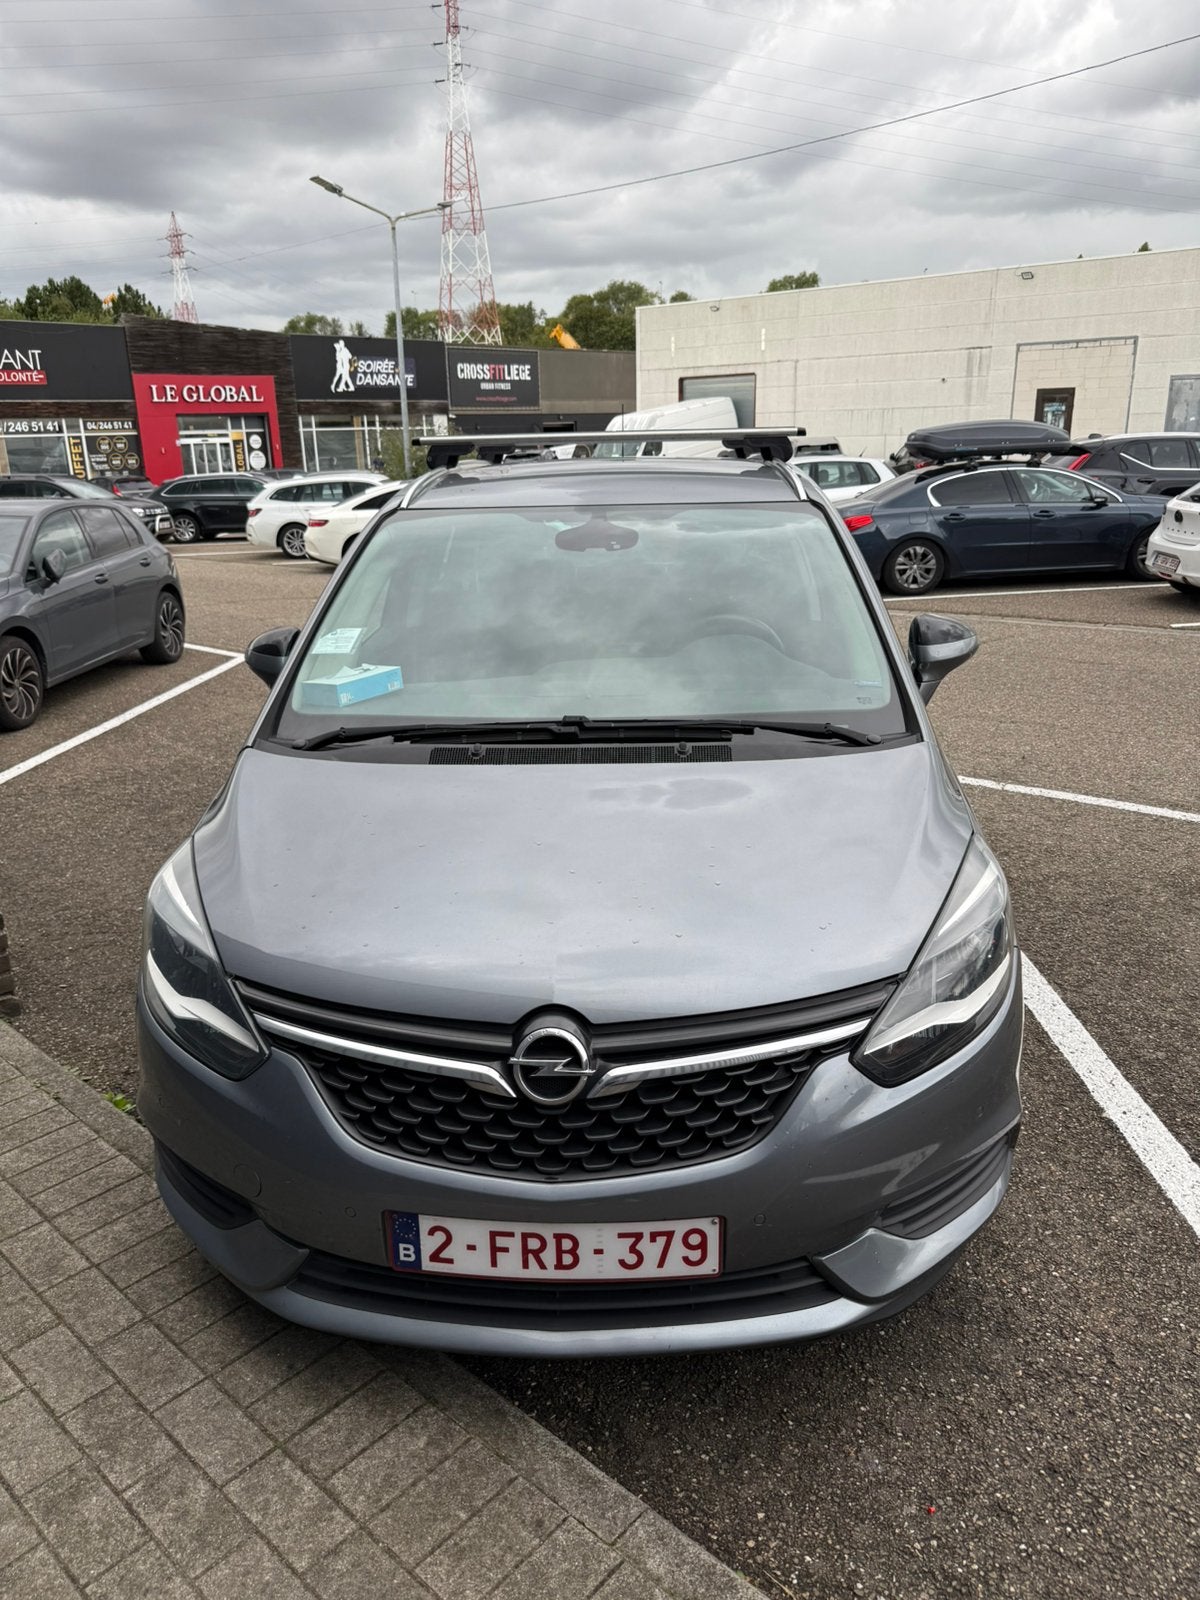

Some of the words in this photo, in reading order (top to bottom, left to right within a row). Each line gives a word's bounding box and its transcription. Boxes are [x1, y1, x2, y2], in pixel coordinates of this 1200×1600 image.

[0, 349, 41, 370] ANT
[358, 359, 395, 373] SOIRÉE
[457, 363, 531, 380] CROSSFITLIEGE
[151, 385, 179, 402] LE
[182, 385, 264, 402] GLOBAL
[31, 421, 44, 432] 51
[46, 421, 60, 432] 41
[123, 421, 132, 430] 41
[399, 1243, 416, 1262] B
